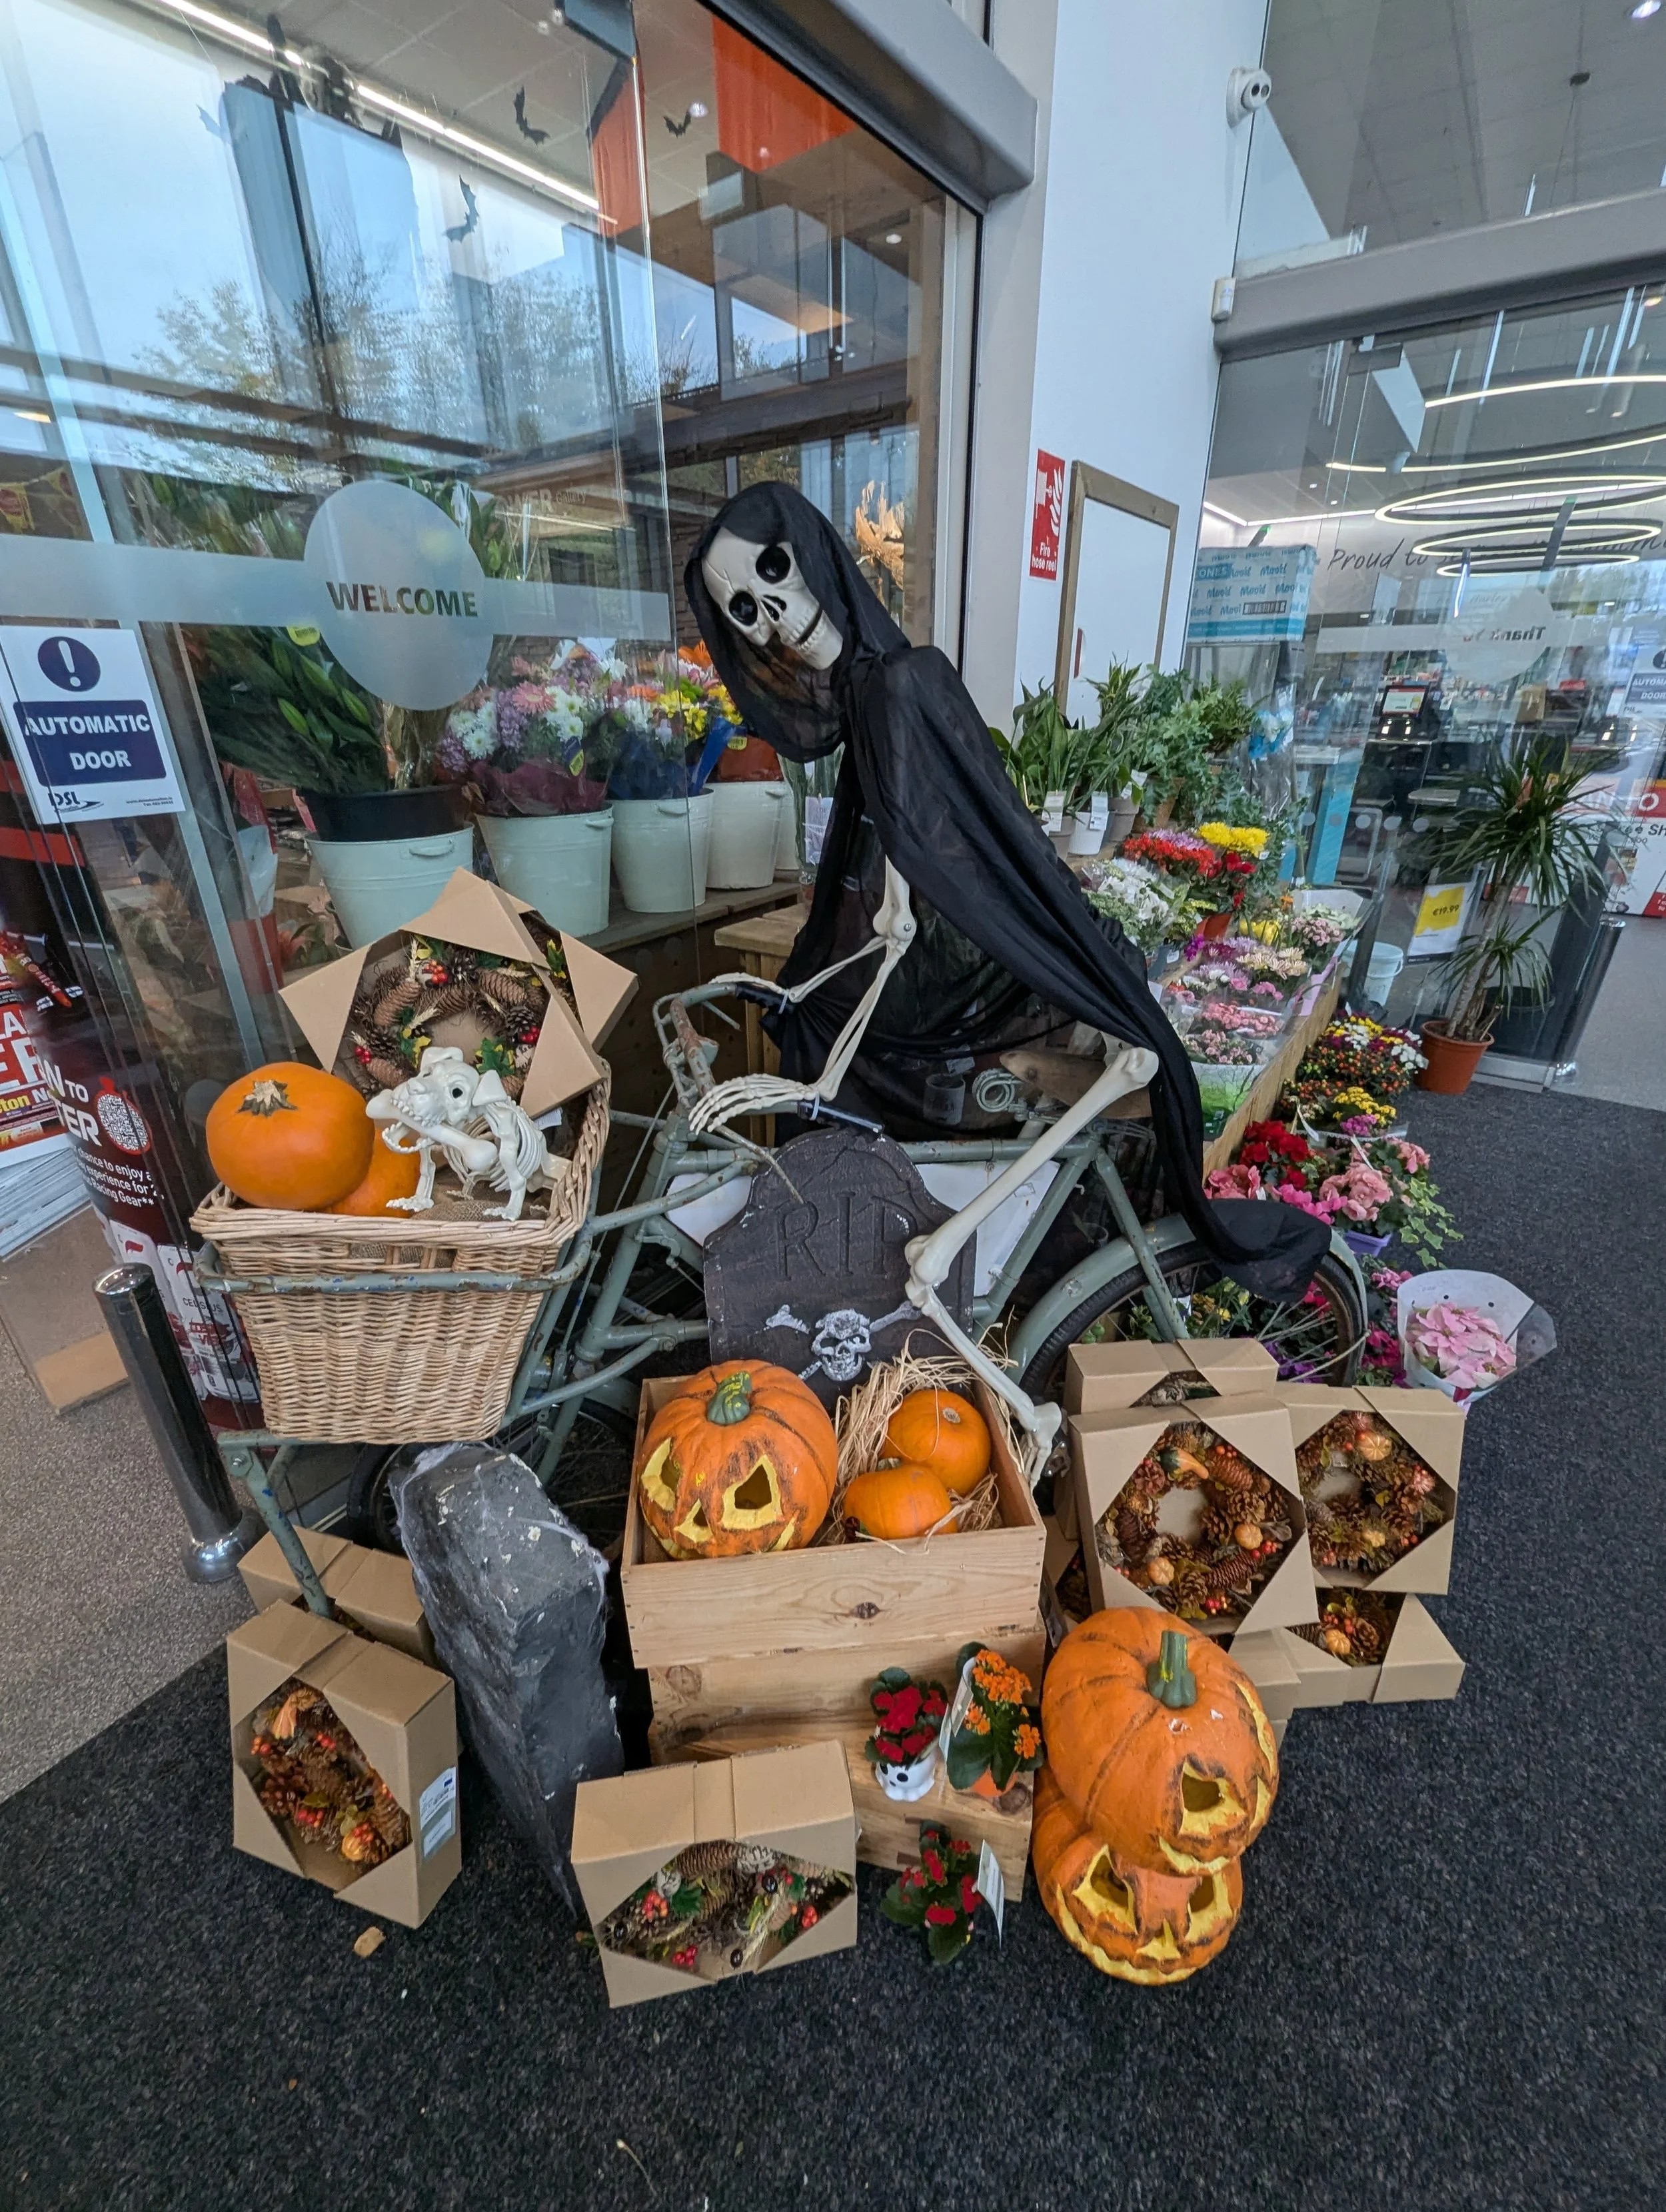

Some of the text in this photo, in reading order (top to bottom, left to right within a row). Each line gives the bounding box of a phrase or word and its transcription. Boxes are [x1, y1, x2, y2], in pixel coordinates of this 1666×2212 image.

[1032, 554, 1057, 572] hose reel
[1327, 538, 1405, 570] Proud
[1405, 551, 1427, 566] to
[325, 581, 478, 618] WELCOME
[25, 714, 151, 736] AUTOMATIC
[69, 750, 132, 770] DOOR
[65, 1079, 89, 1103] TO
[0, 1095, 31, 1114] ton
[87, 1166, 131, 1191] experience
[132, 1180, 149, 1195] for
[104, 1158, 114, 1172] to
[115, 1164, 143, 1182] enjoy
[92, 1177, 119, 1203] Racing
[773, 1191, 919, 1282] RIP
[182, 1297, 222, 1313] CELSUS
